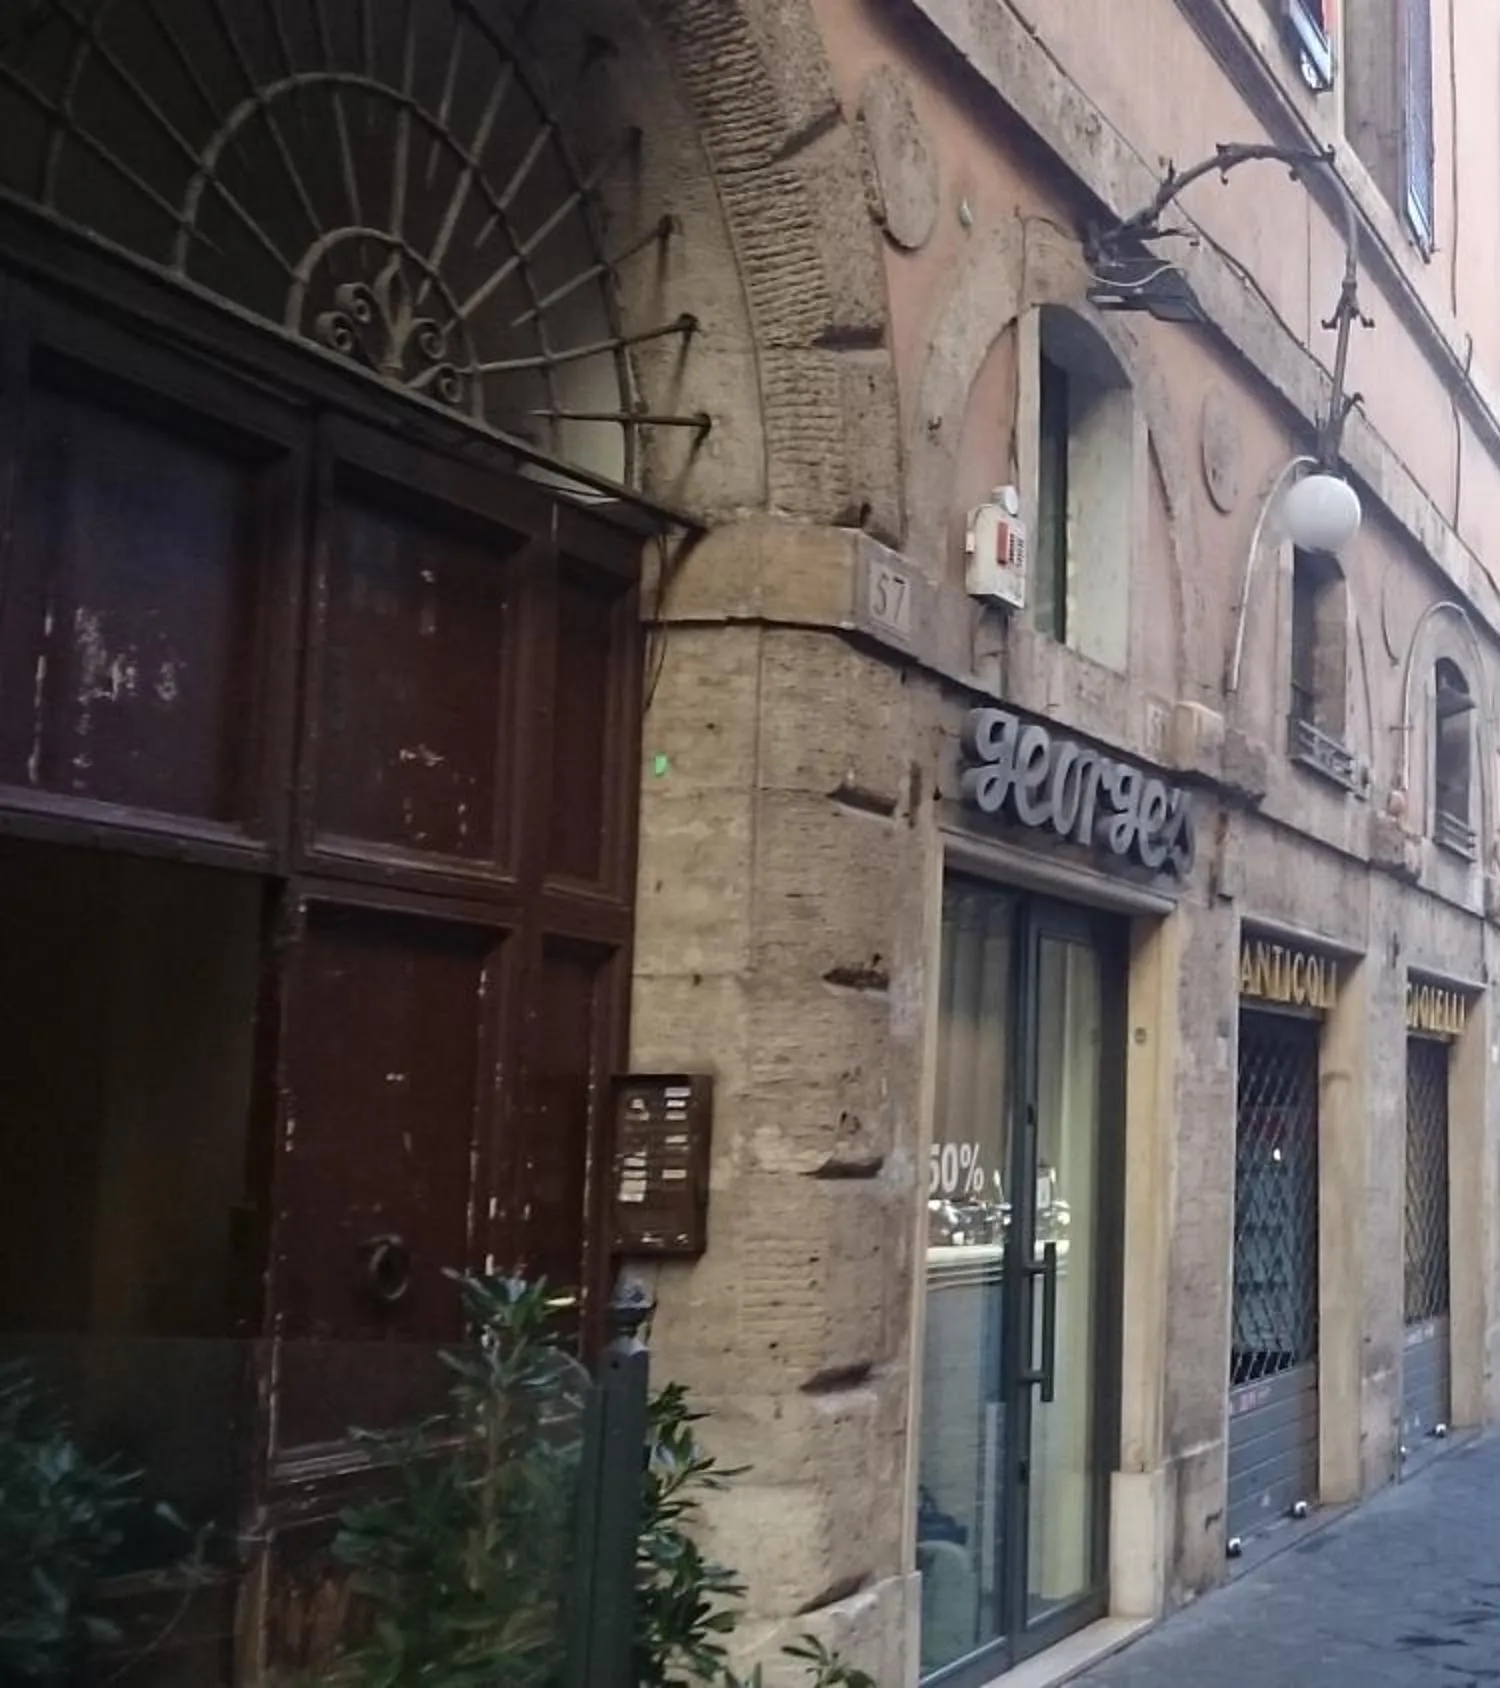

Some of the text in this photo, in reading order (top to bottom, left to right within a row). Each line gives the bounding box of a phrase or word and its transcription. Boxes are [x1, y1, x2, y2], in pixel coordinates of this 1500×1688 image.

[873, 572, 906, 623] 57
[1240, 940, 1338, 1010] ANTICOLI
[929, 1142, 985, 1193] 50%
